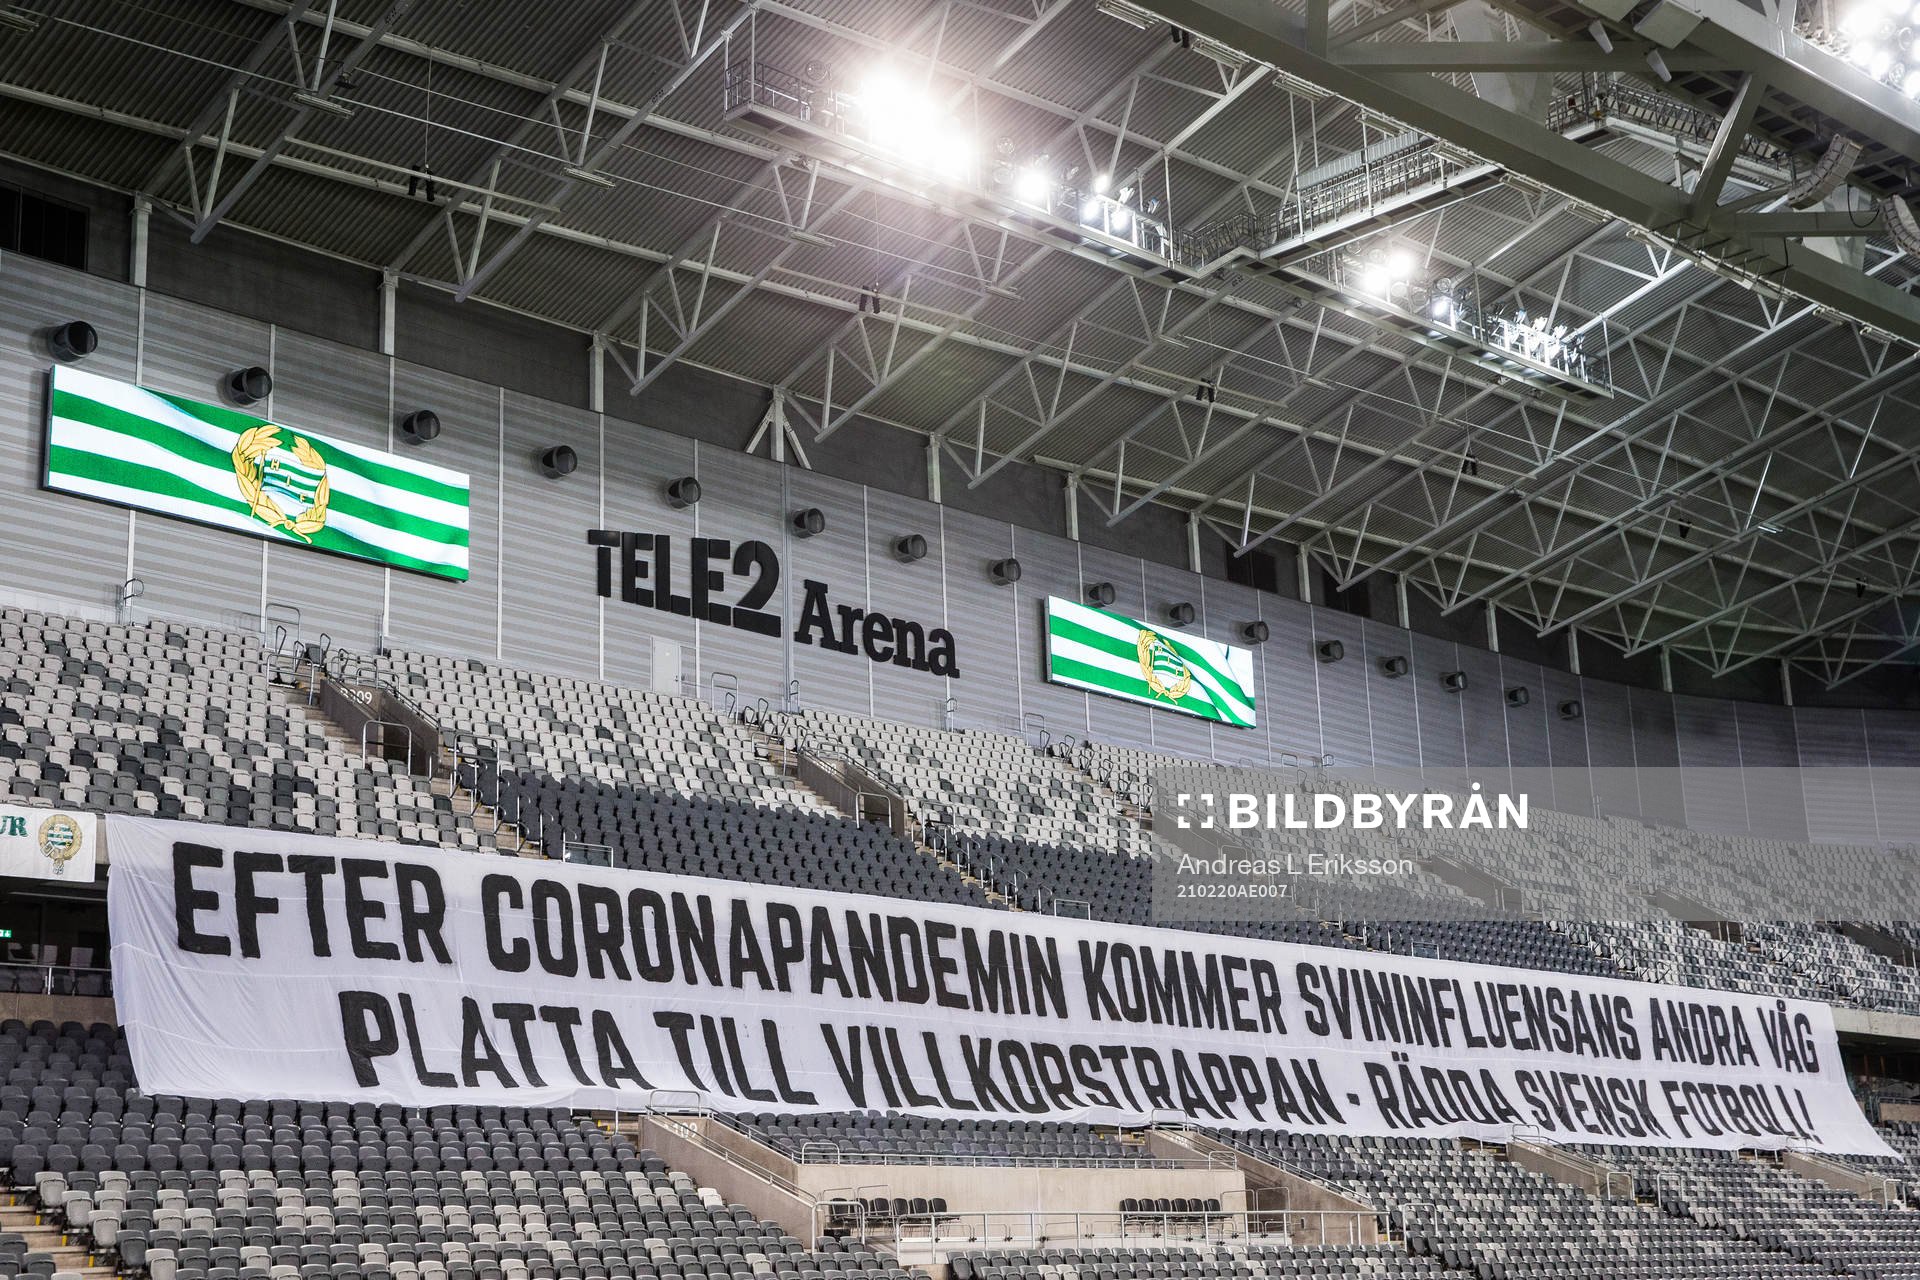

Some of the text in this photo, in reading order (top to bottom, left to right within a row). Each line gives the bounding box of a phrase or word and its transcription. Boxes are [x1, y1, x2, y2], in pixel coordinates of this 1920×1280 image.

[586, 528, 961, 680] TELE2 Arena
[173, 841, 1820, 1074] EFTER CORONAPANDEMIN KOMMER SVININFLUENSANS ANDRA VÅG
[338, 990, 1824, 1145] PLATTA TILL VILLKORSTRAPPAN - RÄDDA SVENSK FOTBOLL!
